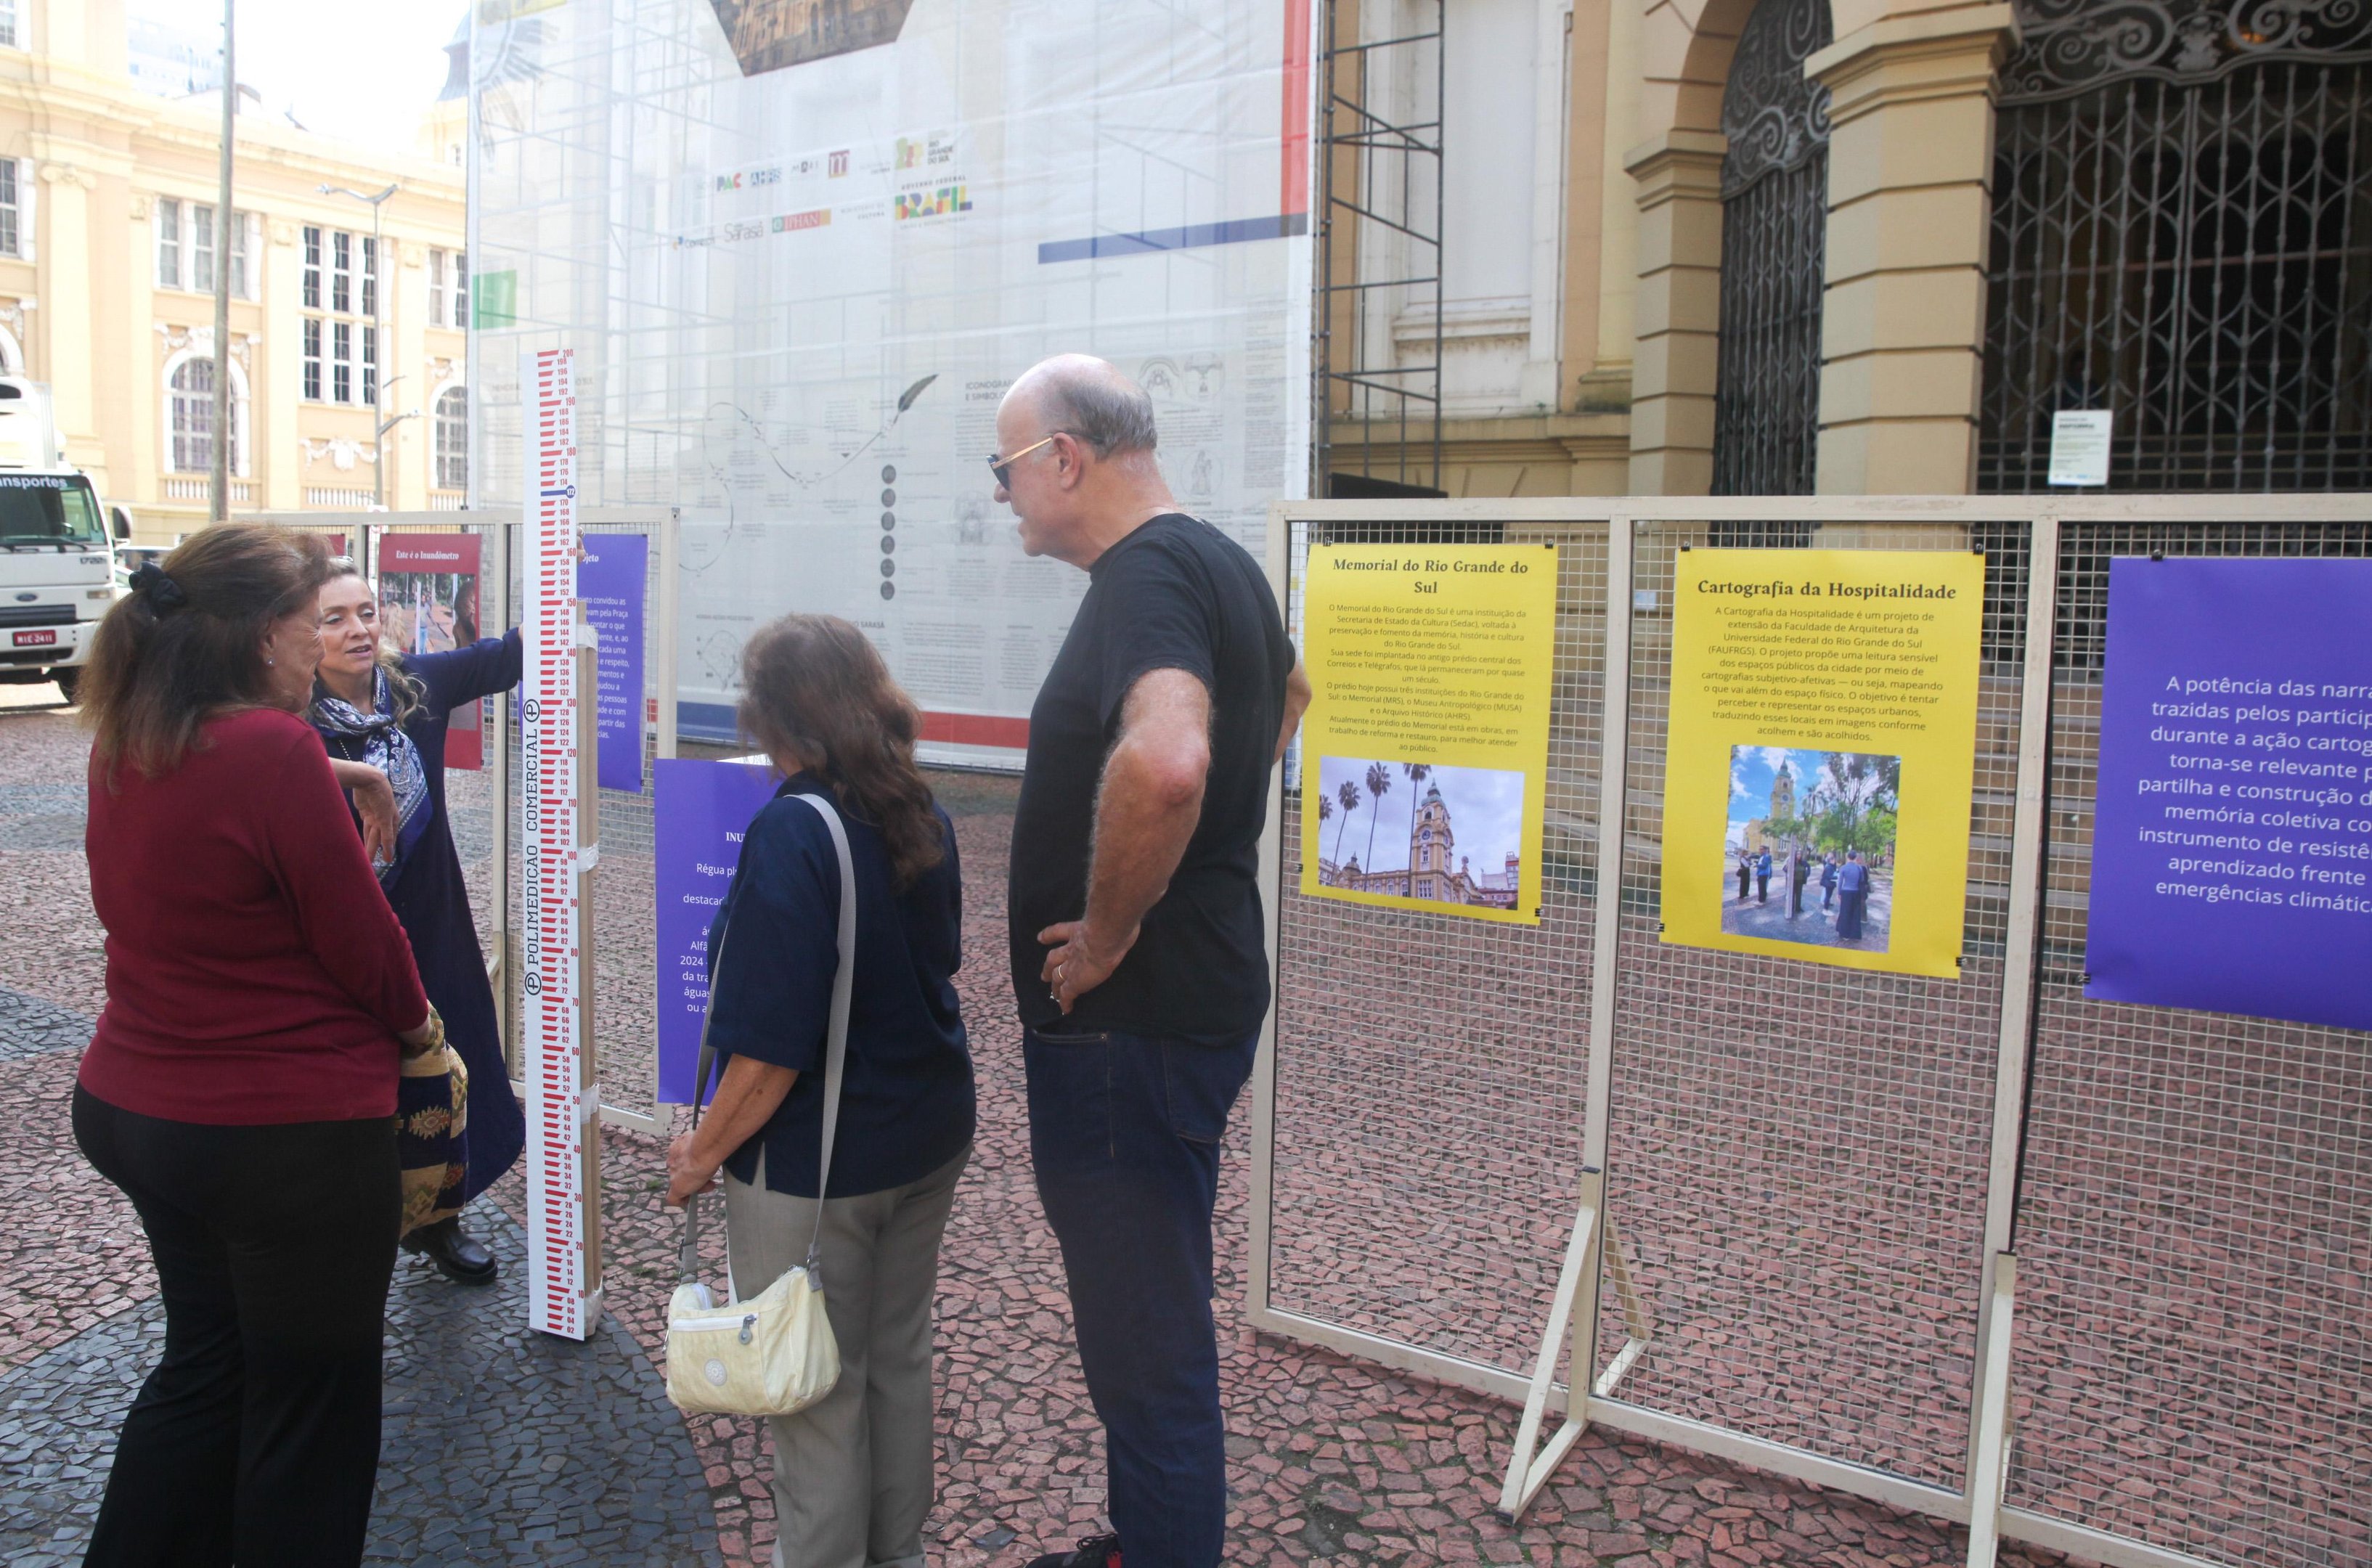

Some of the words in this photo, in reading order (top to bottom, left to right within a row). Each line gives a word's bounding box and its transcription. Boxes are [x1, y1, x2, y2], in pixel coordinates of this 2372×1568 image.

[717, 173, 742, 192] PAC
[894, 185, 973, 221] BRASIL
[566, 396, 575, 406] 190
[566, 447, 576, 456] 180
[1333, 559, 1397, 571] Memorial
[1403, 559, 1419, 571] do
[1425, 560, 1448, 571] Rio
[1454, 560, 1504, 572] Grande
[1510, 561, 1528, 573] do
[1414, 581, 1436, 593] Sul
[1698, 580, 1793, 597] Cartografia
[1801, 581, 1820, 595] da
[1829, 582, 1955, 600] Hospitalidade
[566, 598, 576, 607] 150
[593, 596, 618, 605] convidou
[600, 608, 611, 618] pela
[613, 609, 628, 619] Praça
[1475, 609, 1514, 618] instituição
[1724, 607, 1773, 617] Cartografia
[1790, 609, 1854, 619] Hospitalidade
[1883, 612, 1918, 622] projeto
[1785, 622, 1831, 631] Faculdade
[1834, 623, 1846, 632] de
[1848, 624, 1903, 634] Arquitetura
[1724, 633, 1782, 642] Universidade
[1785, 635, 1818, 644] Federal
[1836, 637, 1851, 645] Rio
[1854, 637, 1889, 647] Grande
[567, 648, 576, 658] 140
[1708, 645, 1756, 656] (FAUFRGS).
[1769, 649, 1802, 658] projeto
[1805, 650, 1838, 660] propõe
[1865, 652, 1896, 661] leitura
[1899, 653, 1937, 662] sensível
[605, 658, 629, 668] respeito,
[1719, 658, 1735, 667] dos
[1737, 661, 1773, 670] espaços
[1776, 661, 1814, 671] públicos
[1831, 664, 1862, 673] cidade
[2166, 676, 2180, 690] A
[2185, 677, 2271, 695] potência
[2278, 679, 2315, 695] das
[567, 698, 576, 707] 130
[2152, 702, 2229, 718] trazidas
[2236, 705, 2290, 723] pelos
[2151, 726, 2228, 744] durante
[2235, 734, 2245, 745] a
[2252, 732, 2300, 751] ação
[2307, 737, 2372, 756] cartog
[568, 749, 576, 758] 120
[2169, 754, 2252, 772] torna-se
[2259, 758, 2357, 777] relevante
[526, 729, 538, 831] COMERCIAL
[2138, 778, 2212, 795] partilha
[2220, 785, 2230, 796] e
[2237, 785, 2352, 807] construção
[2165, 806, 2254, 823] memória
[2261, 811, 2339, 830] coletiva
[2347, 820, 2371, 832] co
[726, 832, 746, 842] INU
[2139, 827, 2260, 850] instrumento
[2267, 836, 2292, 852] de
[2299, 841, 2372, 859] resistê
[568, 852, 576, 860] 100
[697, 863, 725, 876] Régua
[2168, 858, 2294, 879] aprendizado
[2301, 865, 2365, 885] frente
[2156, 882, 2282, 904] emergências
[2289, 891, 2372, 912] climátic
[524, 845, 540, 965] POLIMEDIÇÃO
[570, 899, 577, 907] 90
[571, 948, 578, 957] 80
[680, 955, 704, 966] 2024
[682, 971, 694, 981] da
[572, 997, 579, 1007] 70
[572, 1047, 579, 1055] 60
[573, 1096, 580, 1105] 50
[574, 1145, 581, 1154] 40
[575, 1193, 582, 1202] 30
[576, 1241, 583, 1251] 20
[578, 1289, 584, 1299] 10
